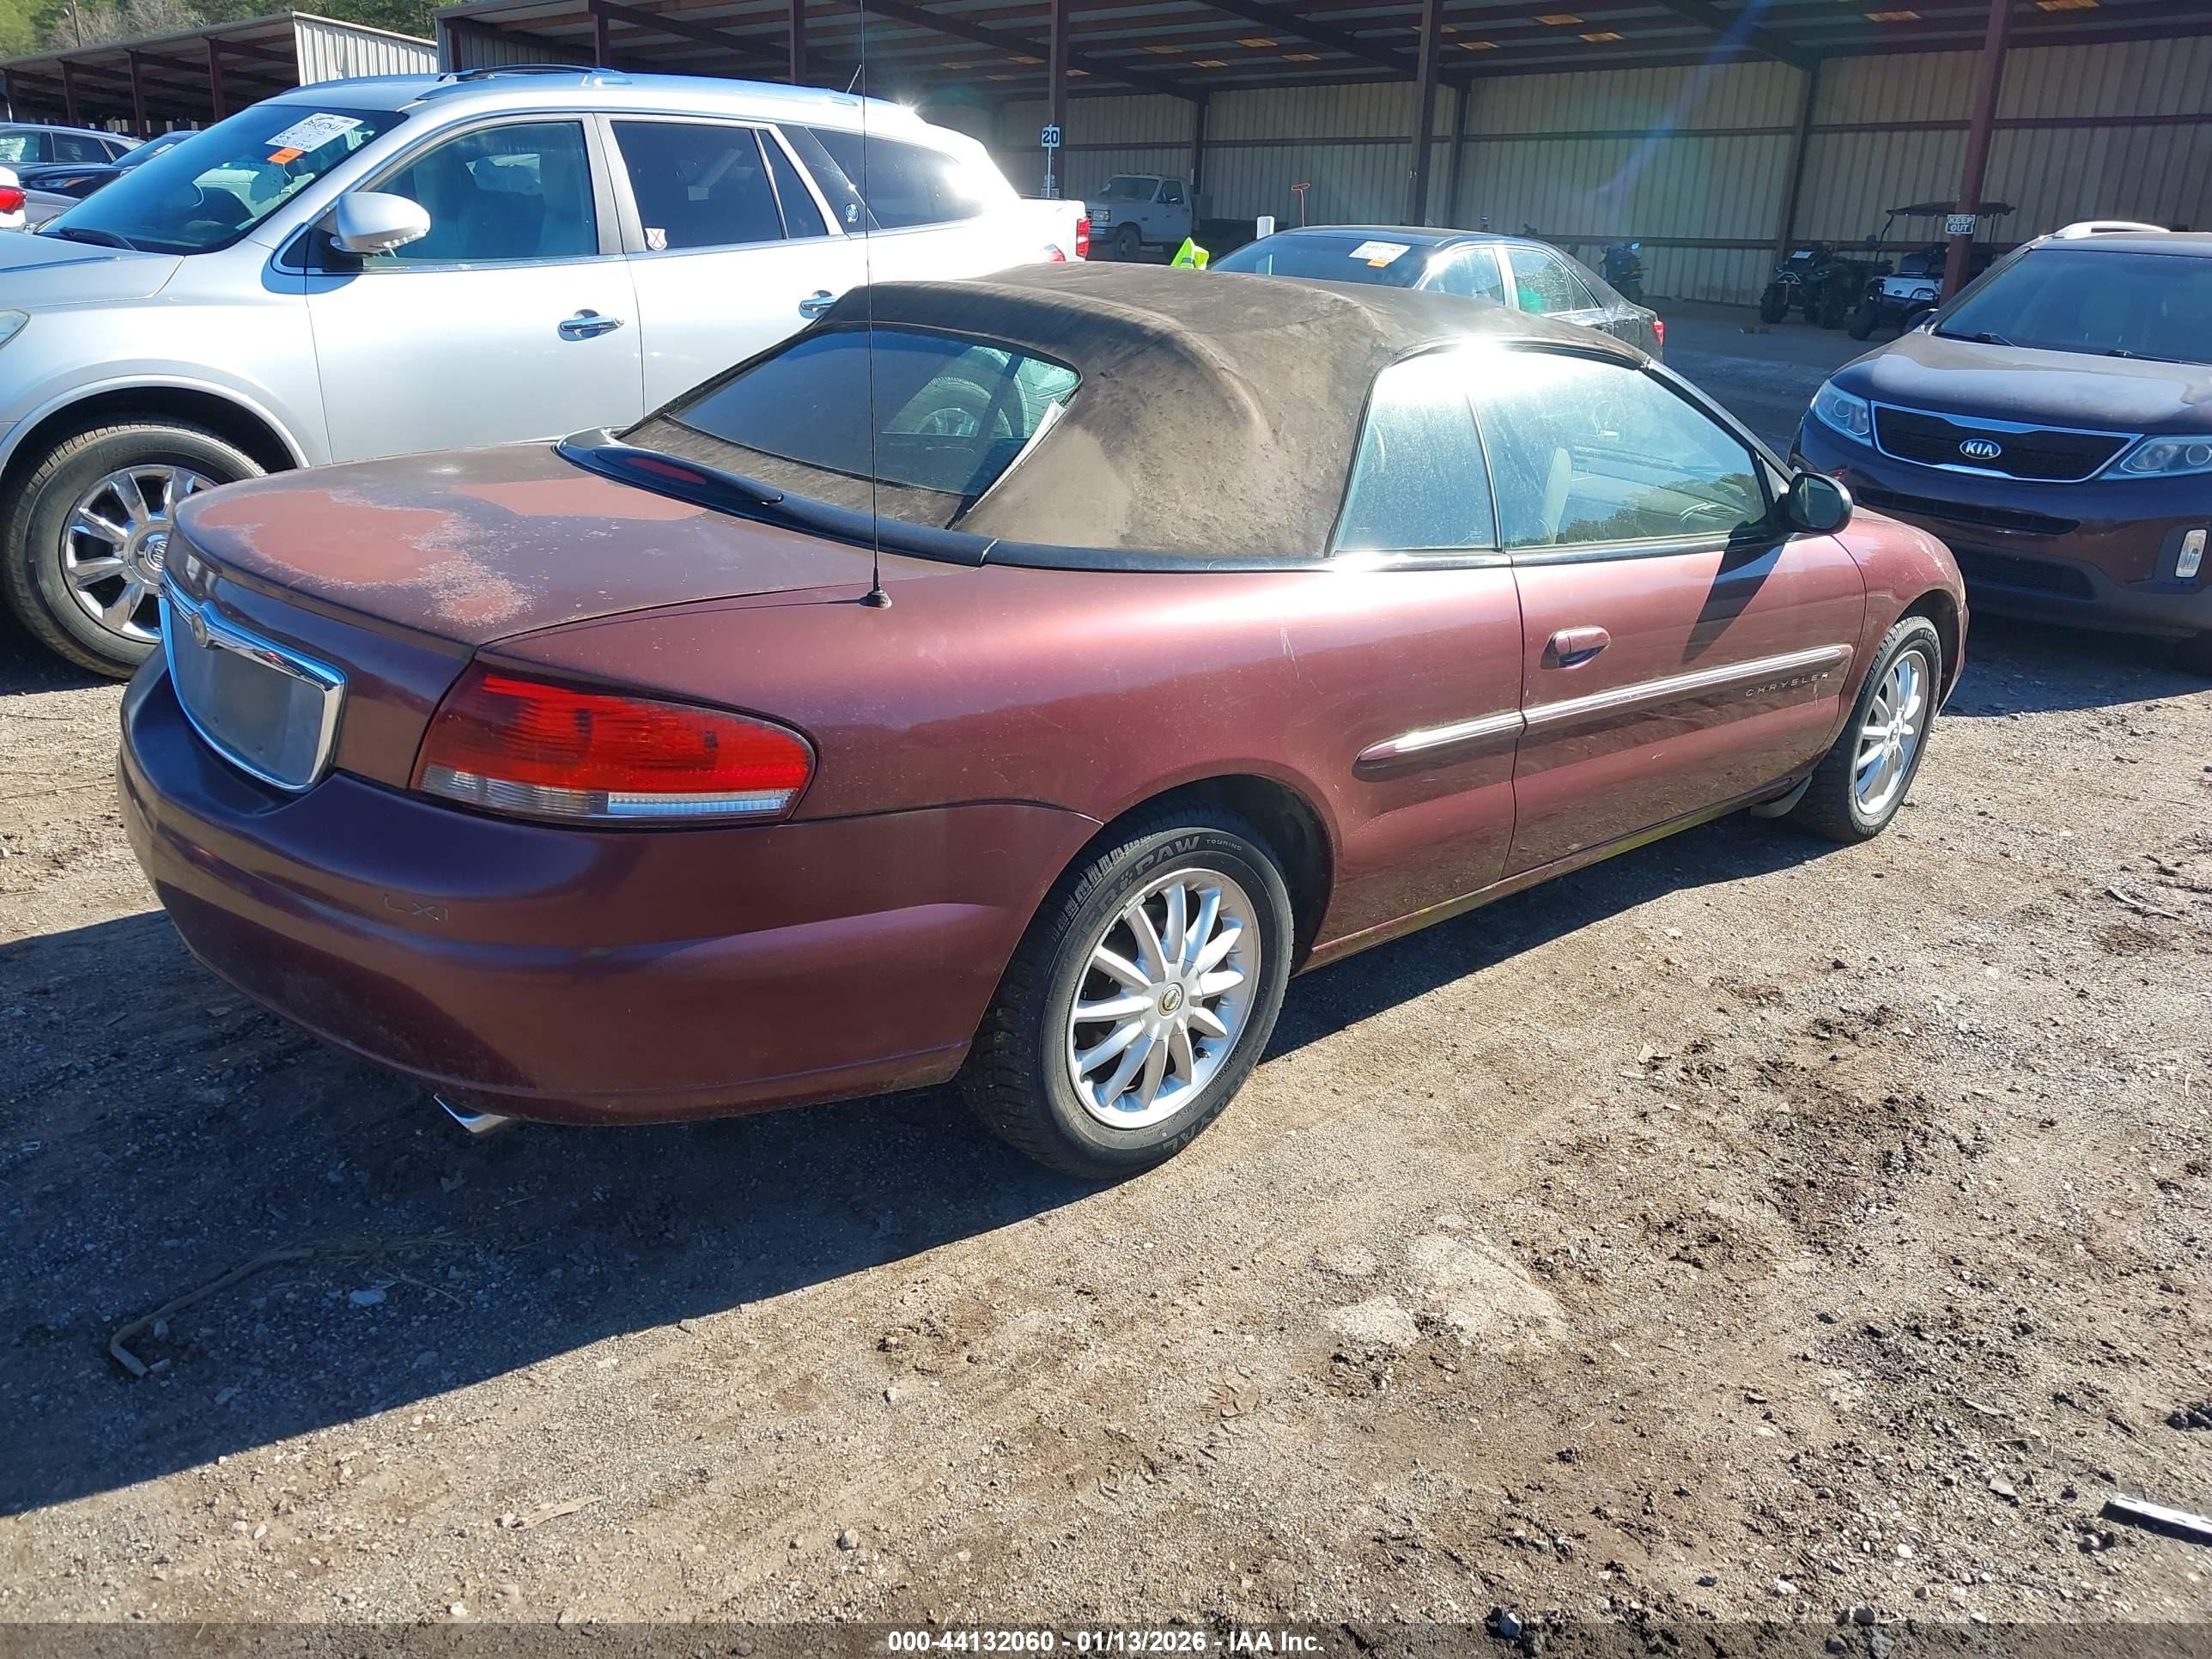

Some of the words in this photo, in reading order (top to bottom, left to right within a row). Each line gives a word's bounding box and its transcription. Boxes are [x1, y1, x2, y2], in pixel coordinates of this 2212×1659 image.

[1043, 130, 1059, 144] 20
[1966, 441, 1993, 456] KIA
[1745, 672, 1829, 697] CHRYSLER
[1135, 836, 1200, 875] PAW
[1206, 838, 1243, 851] TOURING
